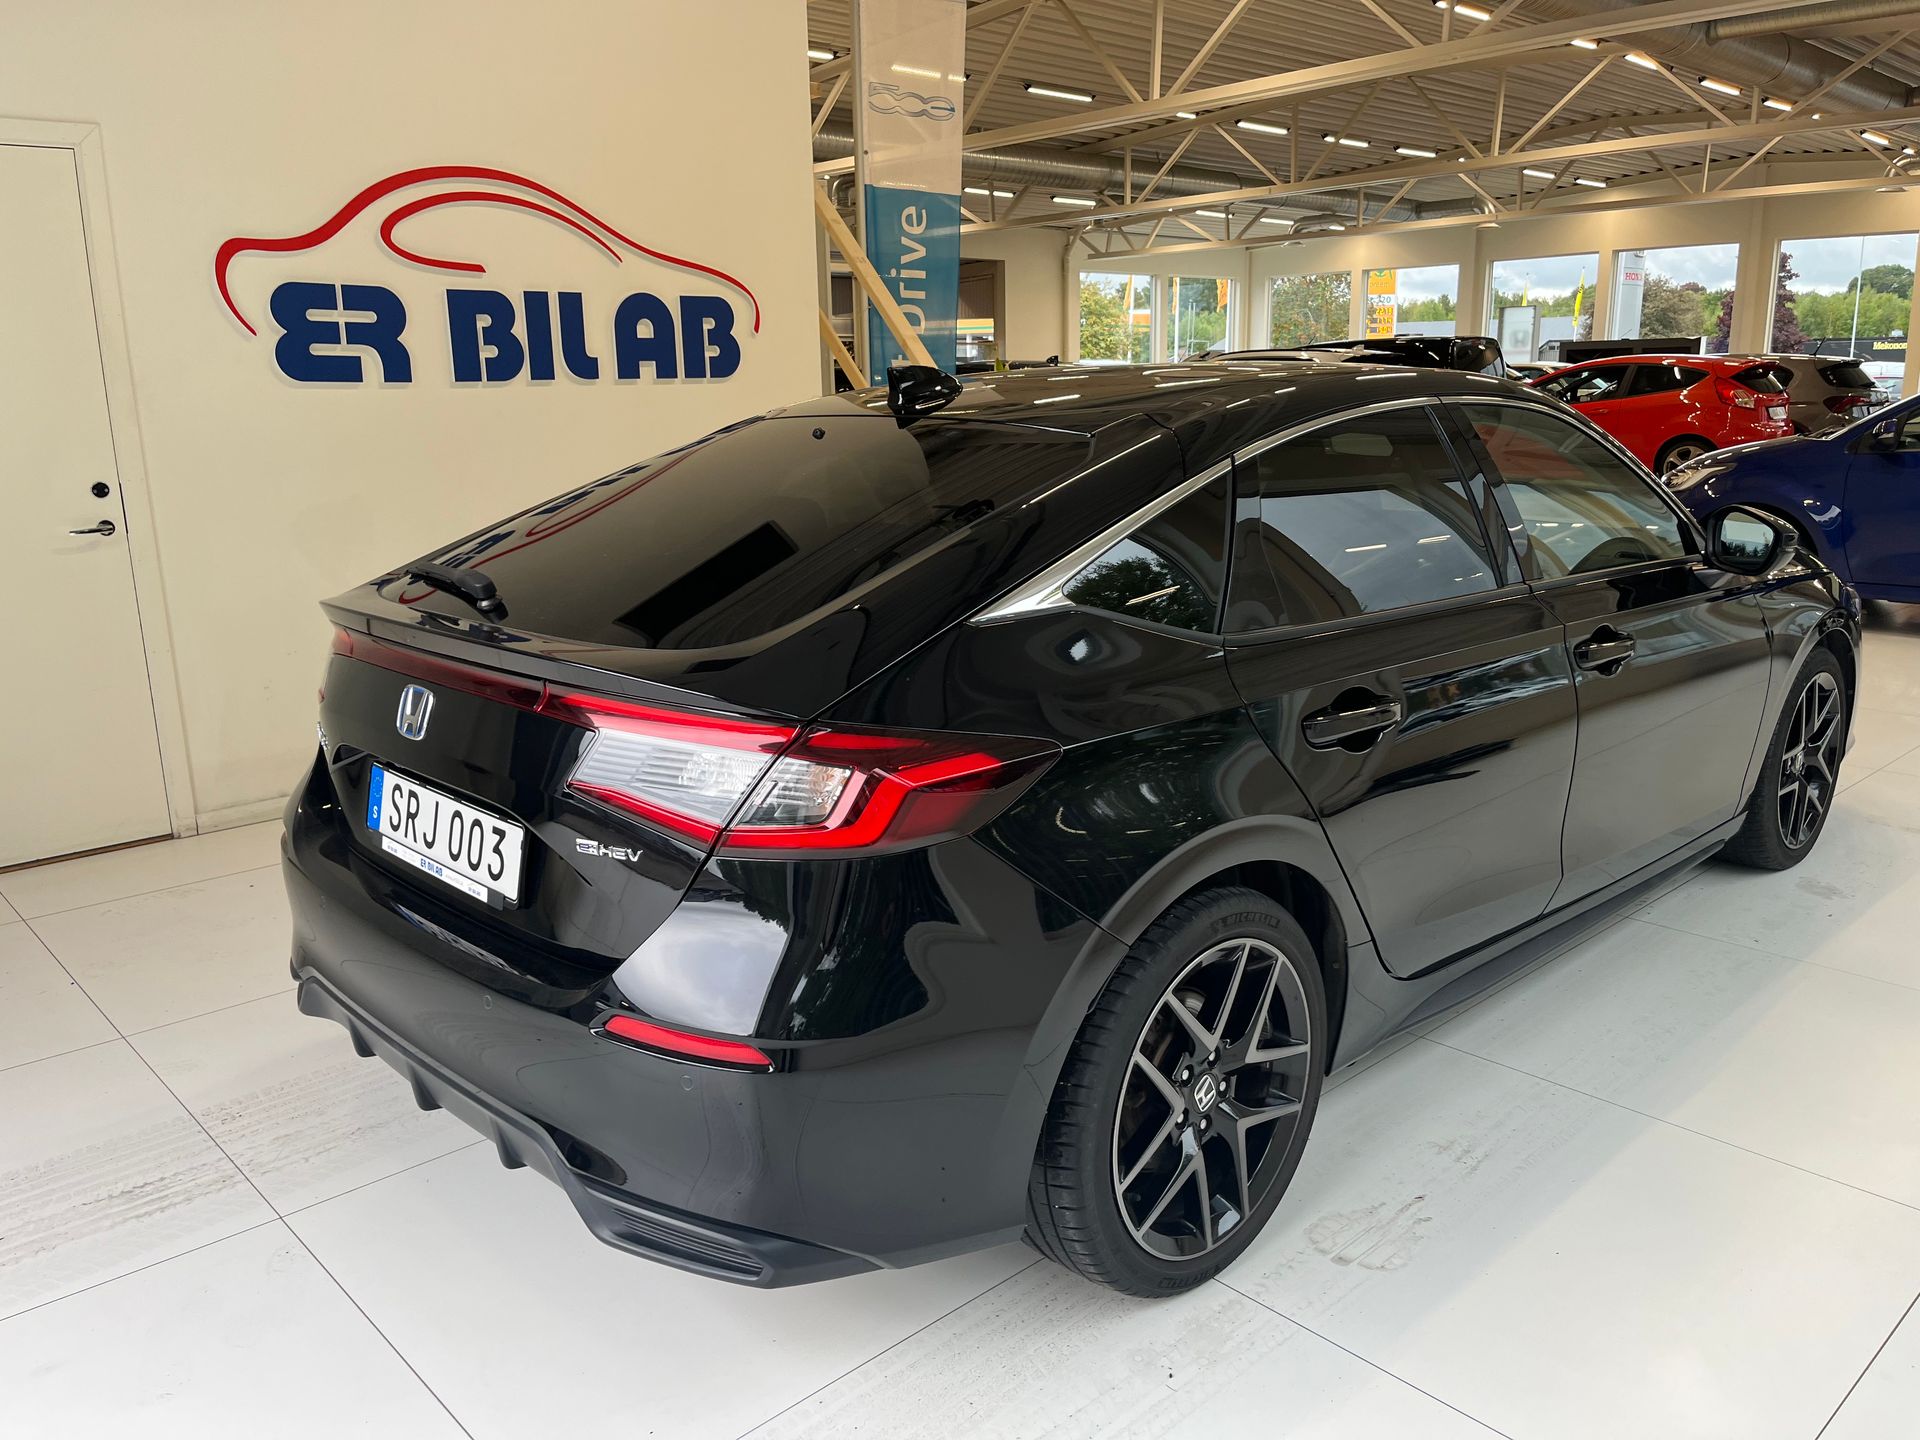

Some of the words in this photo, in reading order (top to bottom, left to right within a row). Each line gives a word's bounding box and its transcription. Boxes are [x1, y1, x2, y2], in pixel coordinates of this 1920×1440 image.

[270, 281, 412, 383] ER
[446, 289, 599, 383] BIL
[614, 292, 741, 380] AB
[372, 805, 378, 818] S
[389, 783, 439, 850] SRJ
[448, 809, 507, 882] 003
